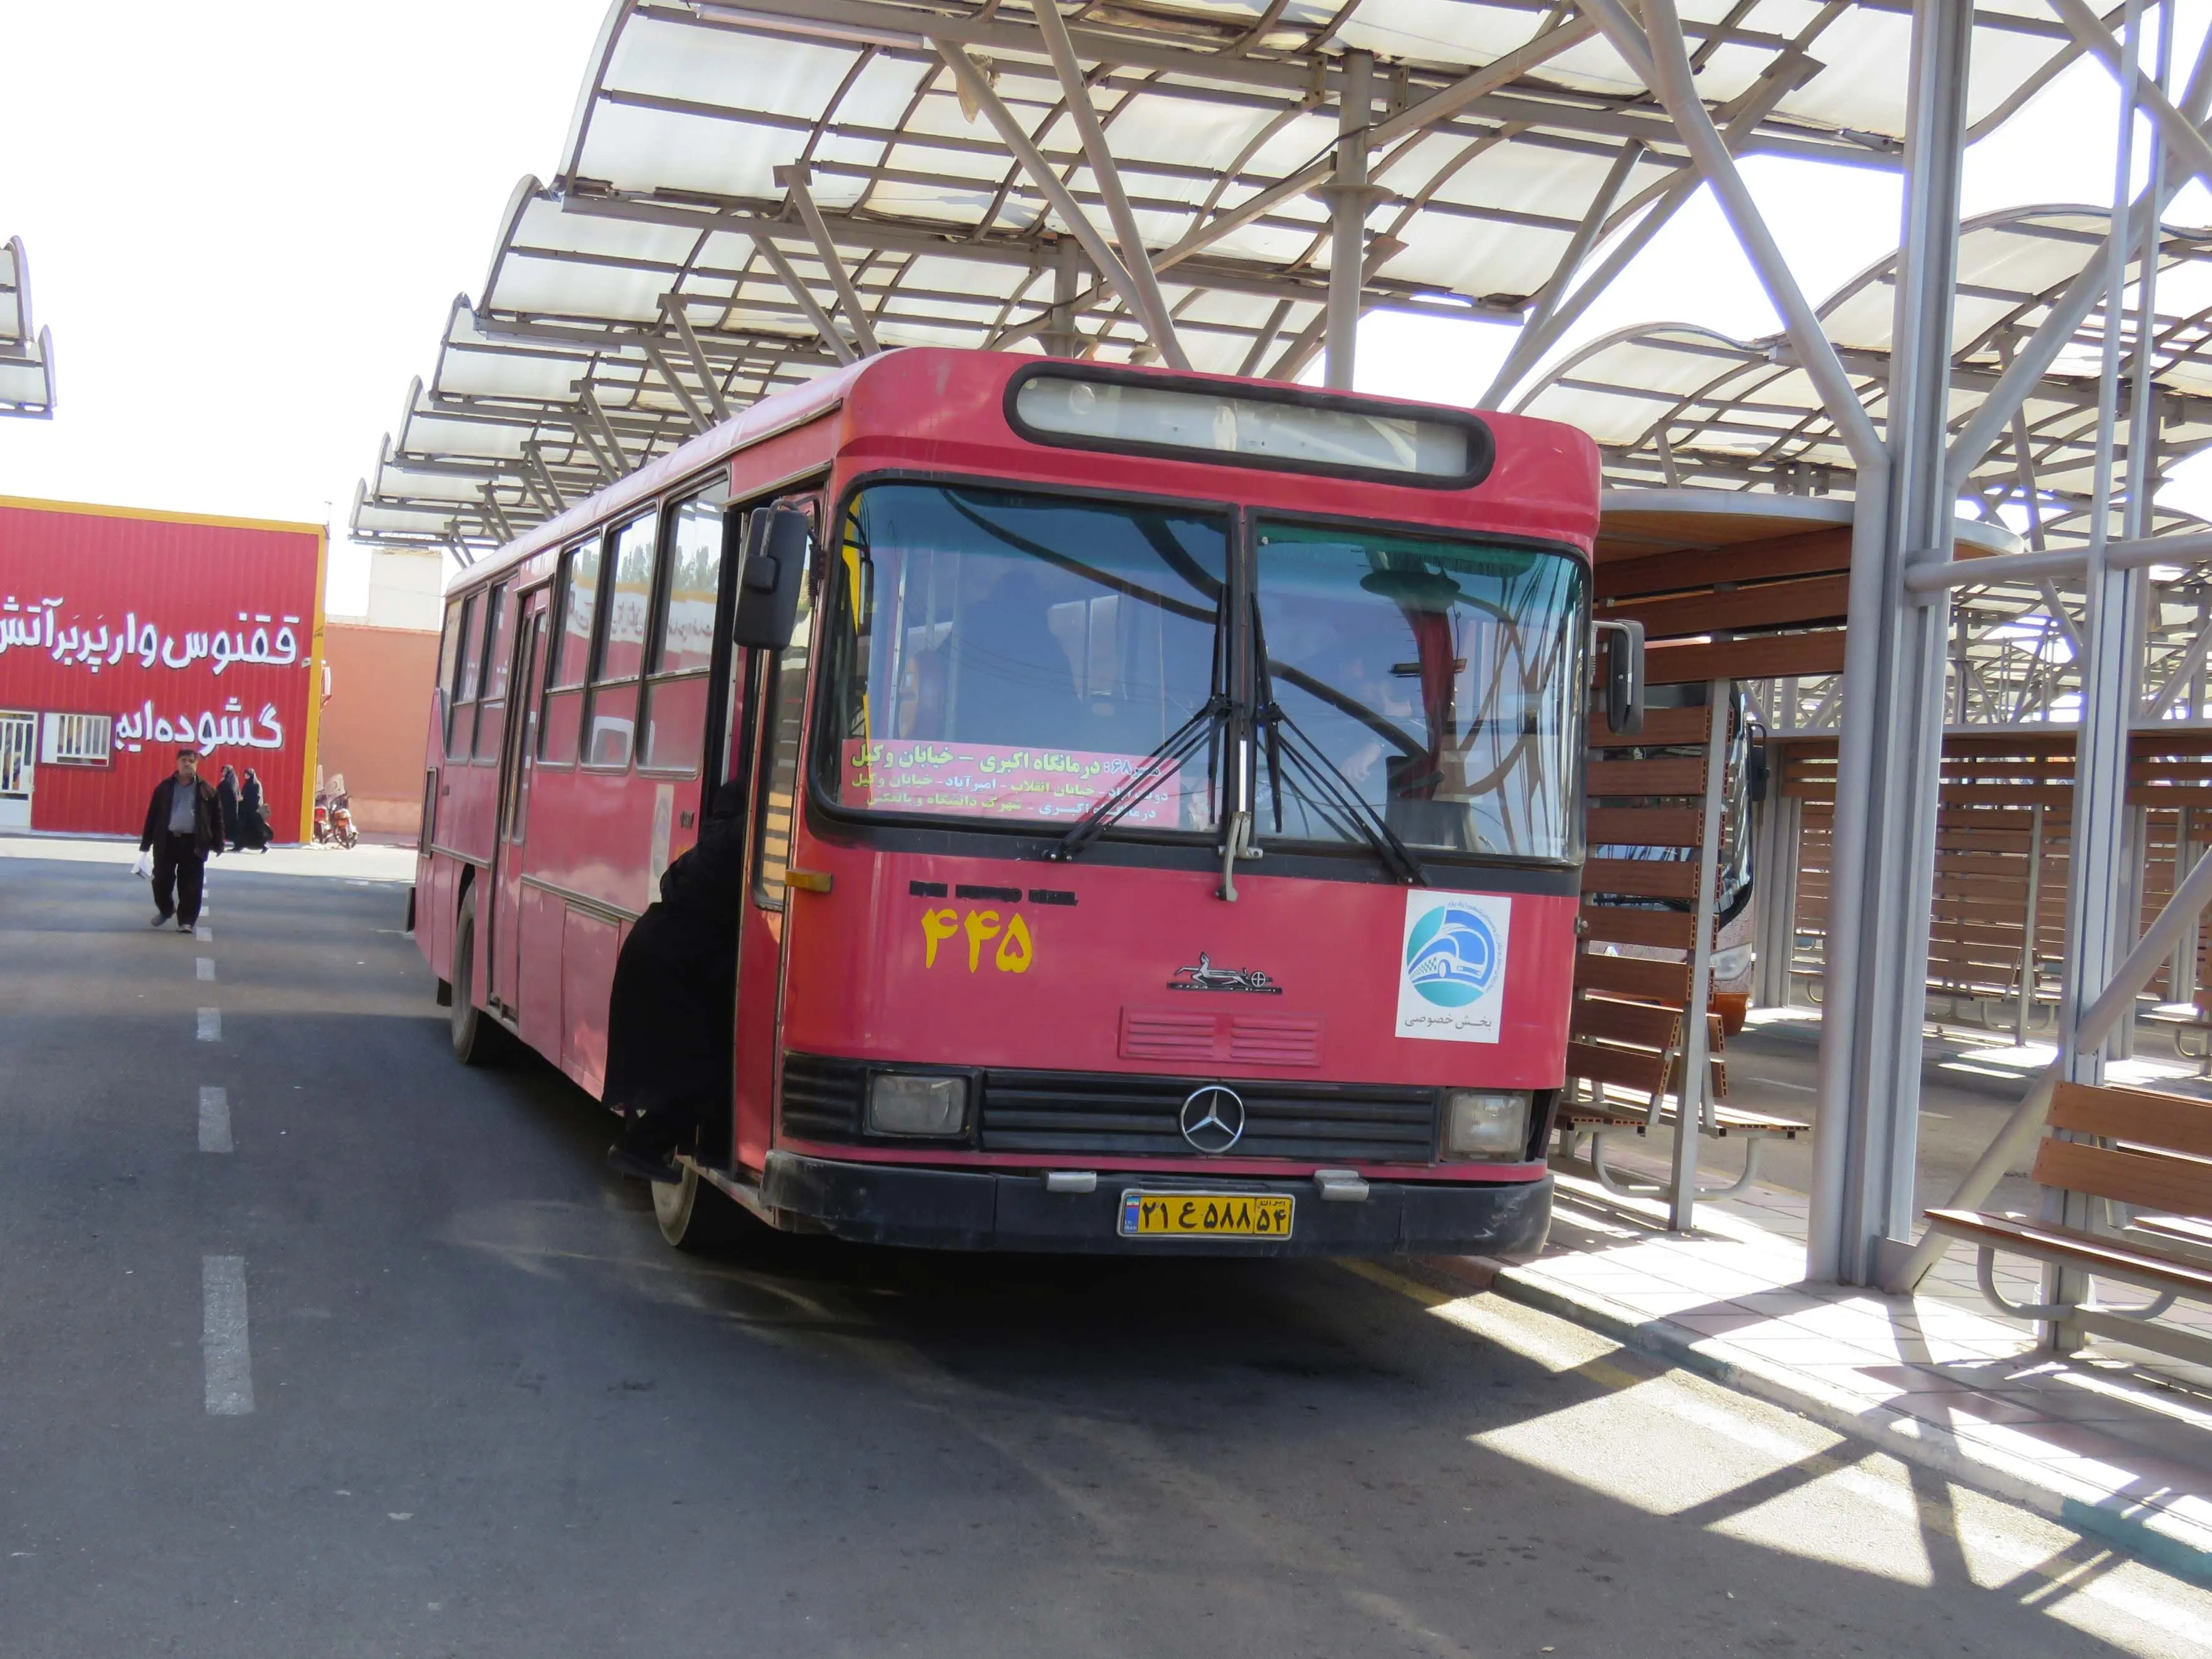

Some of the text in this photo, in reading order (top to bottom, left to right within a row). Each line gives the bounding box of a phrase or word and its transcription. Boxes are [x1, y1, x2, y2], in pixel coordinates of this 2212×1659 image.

[0, 596, 64, 654] آتش
[107, 612, 157, 668] وار
[162, 612, 300, 675] ققنوس
[898, 744, 954, 769] خیابان
[980, 751, 1029, 774] اکبری
[1033, 752, 1101, 780] درمانگاه
[889, 774, 933, 788] خیابان
[1010, 780, 1050, 794] انقلاب
[1054, 784, 1095, 798] خیابان
[927, 793, 977, 807] دانشگاه
[920, 908, 1033, 973] ۴۴۵
[1404, 1013, 1492, 1031] بخش خصوصی
